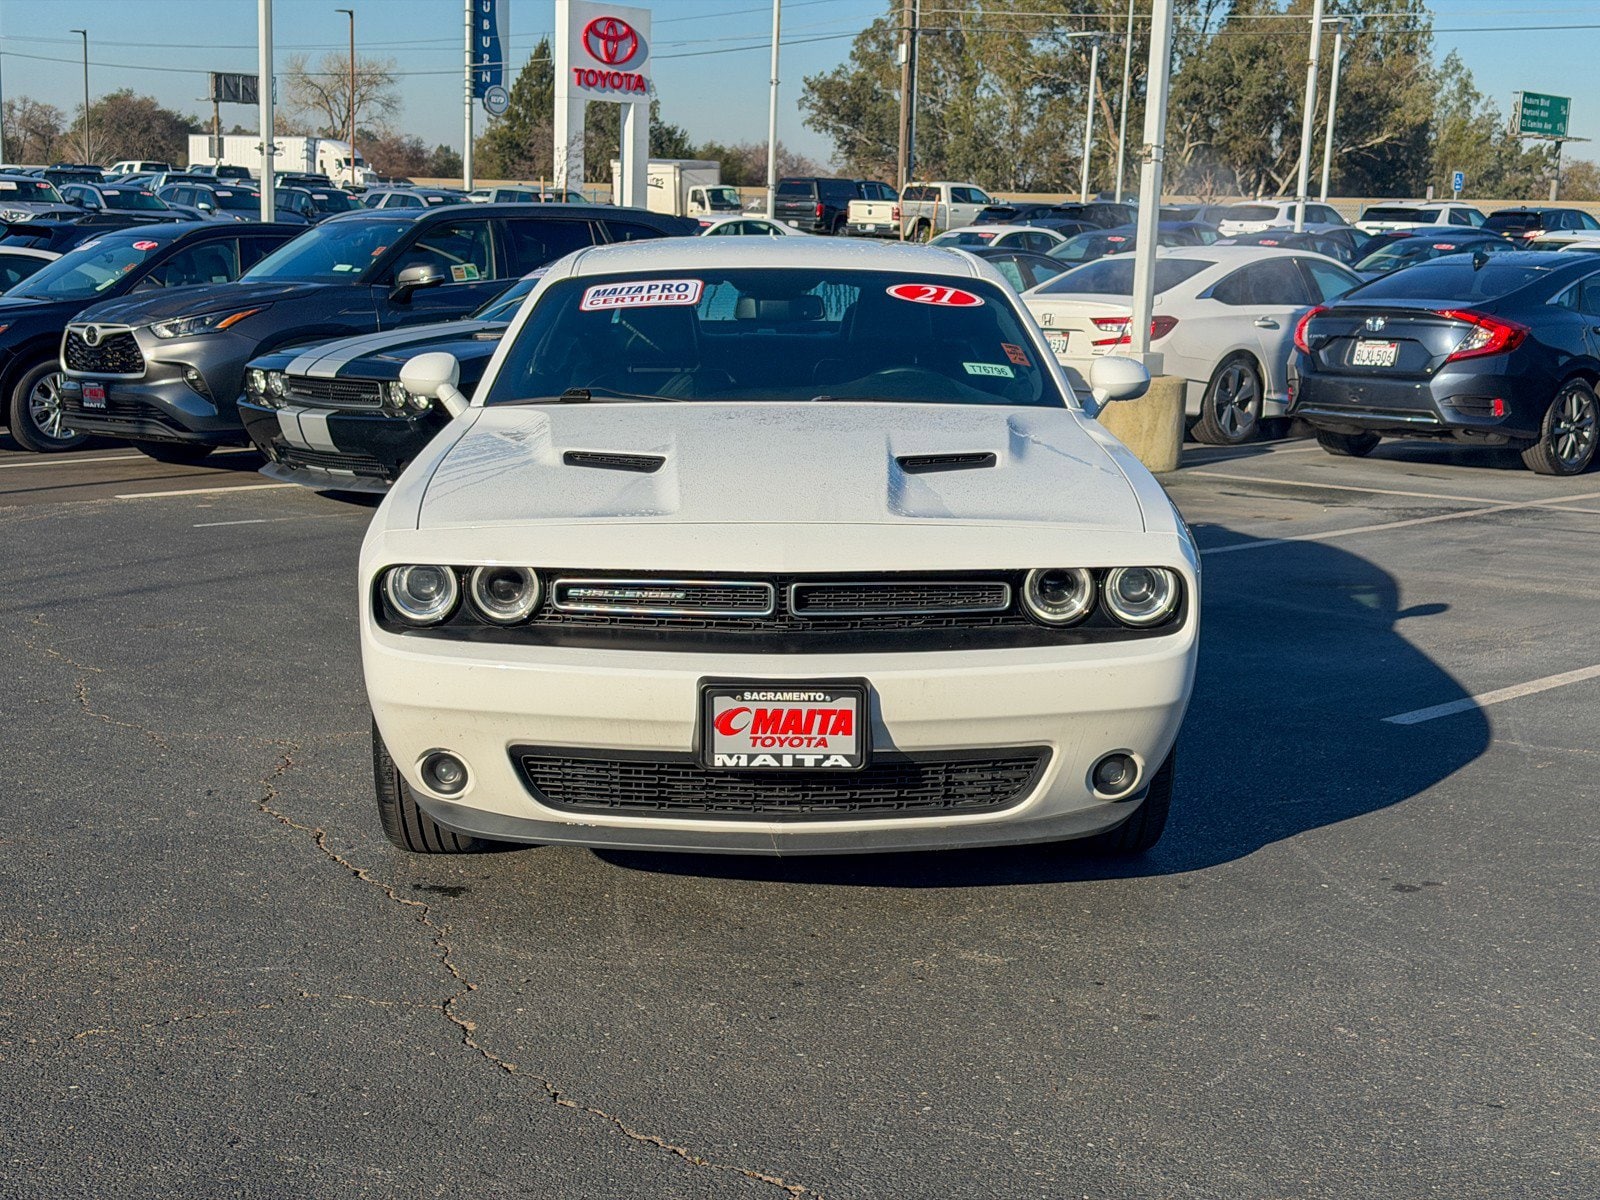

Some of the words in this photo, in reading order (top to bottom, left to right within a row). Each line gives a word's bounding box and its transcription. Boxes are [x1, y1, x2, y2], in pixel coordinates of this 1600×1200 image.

[573, 68, 647, 93] TOYOTA
[589, 293, 690, 306] CERTIFIED
[914, 286, 957, 304] 21
[968, 364, 1009, 376] T76796
[567, 588, 687, 600] CHALLENGER
[743, 691, 825, 701] SACRAMENTO
[749, 736, 830, 749] TOYOTA
[714, 754, 853, 768] MAITA
